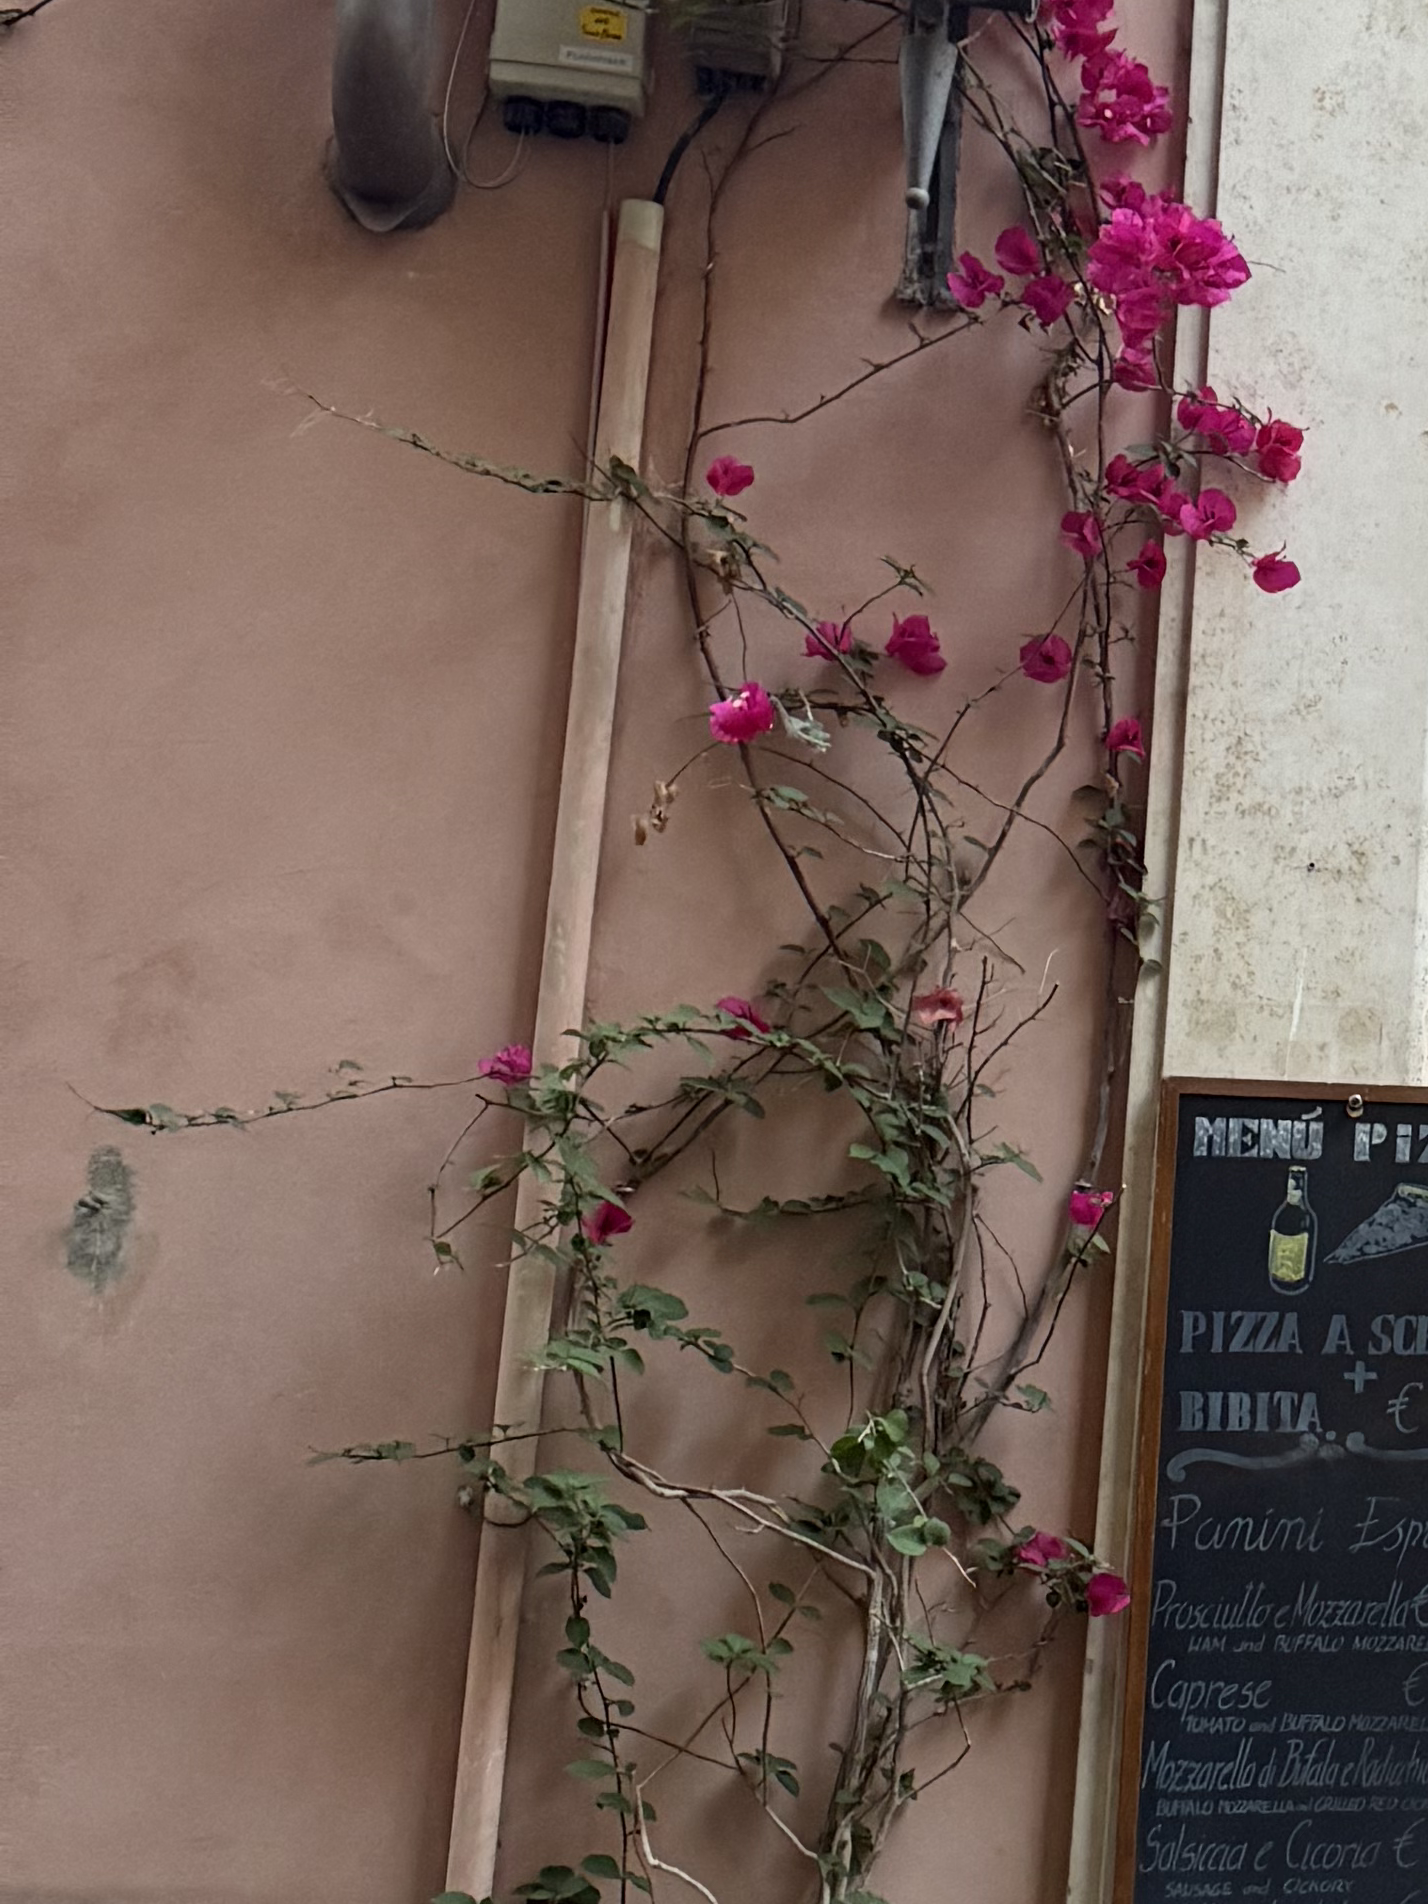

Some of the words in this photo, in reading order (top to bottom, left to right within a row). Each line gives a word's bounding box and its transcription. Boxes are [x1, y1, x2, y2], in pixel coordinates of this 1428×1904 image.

[1179, 1310, 1303, 1355] PIZZA
[1321, 1314, 1354, 1356] A
[1178, 1390, 1323, 1433] BIBITA
[1161, 1494, 1324, 1553] Panini
[1151, 1579, 1271, 1631] Prosciutto
[1149, 1658, 1273, 1722] Caprese
